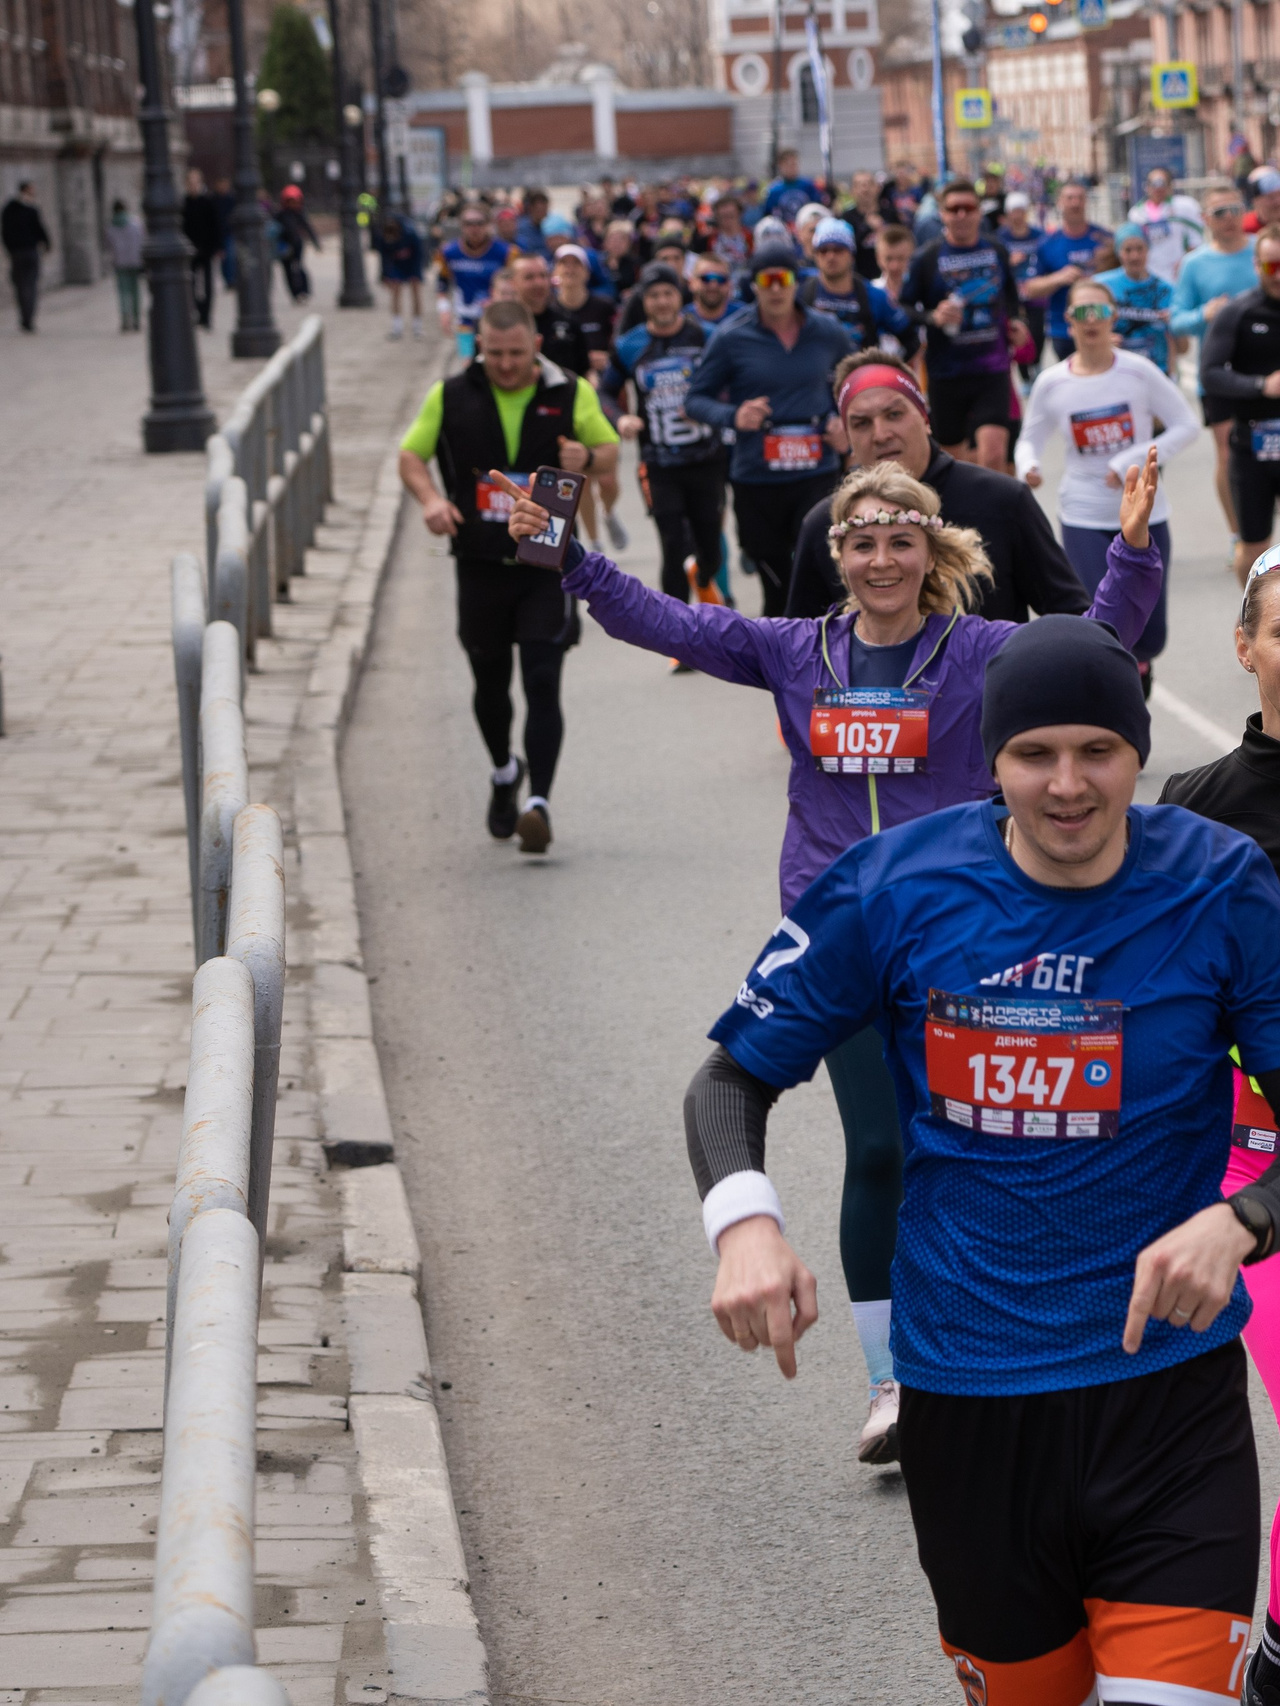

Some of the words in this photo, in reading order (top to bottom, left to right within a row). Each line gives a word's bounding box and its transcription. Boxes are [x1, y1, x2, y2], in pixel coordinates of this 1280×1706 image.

[835, 722, 900, 754] 1037
[757, 915, 810, 979] 7
[982, 1014, 1061, 1027] КОСМОС
[995, 1005, 1061, 1016] ПРОСТО
[995, 1036, 1038, 1048] ДЕНИС
[968, 1053, 1075, 1106] 1347
[1090, 1064, 1107, 1081] D
[1228, 1619, 1250, 1692] 7
